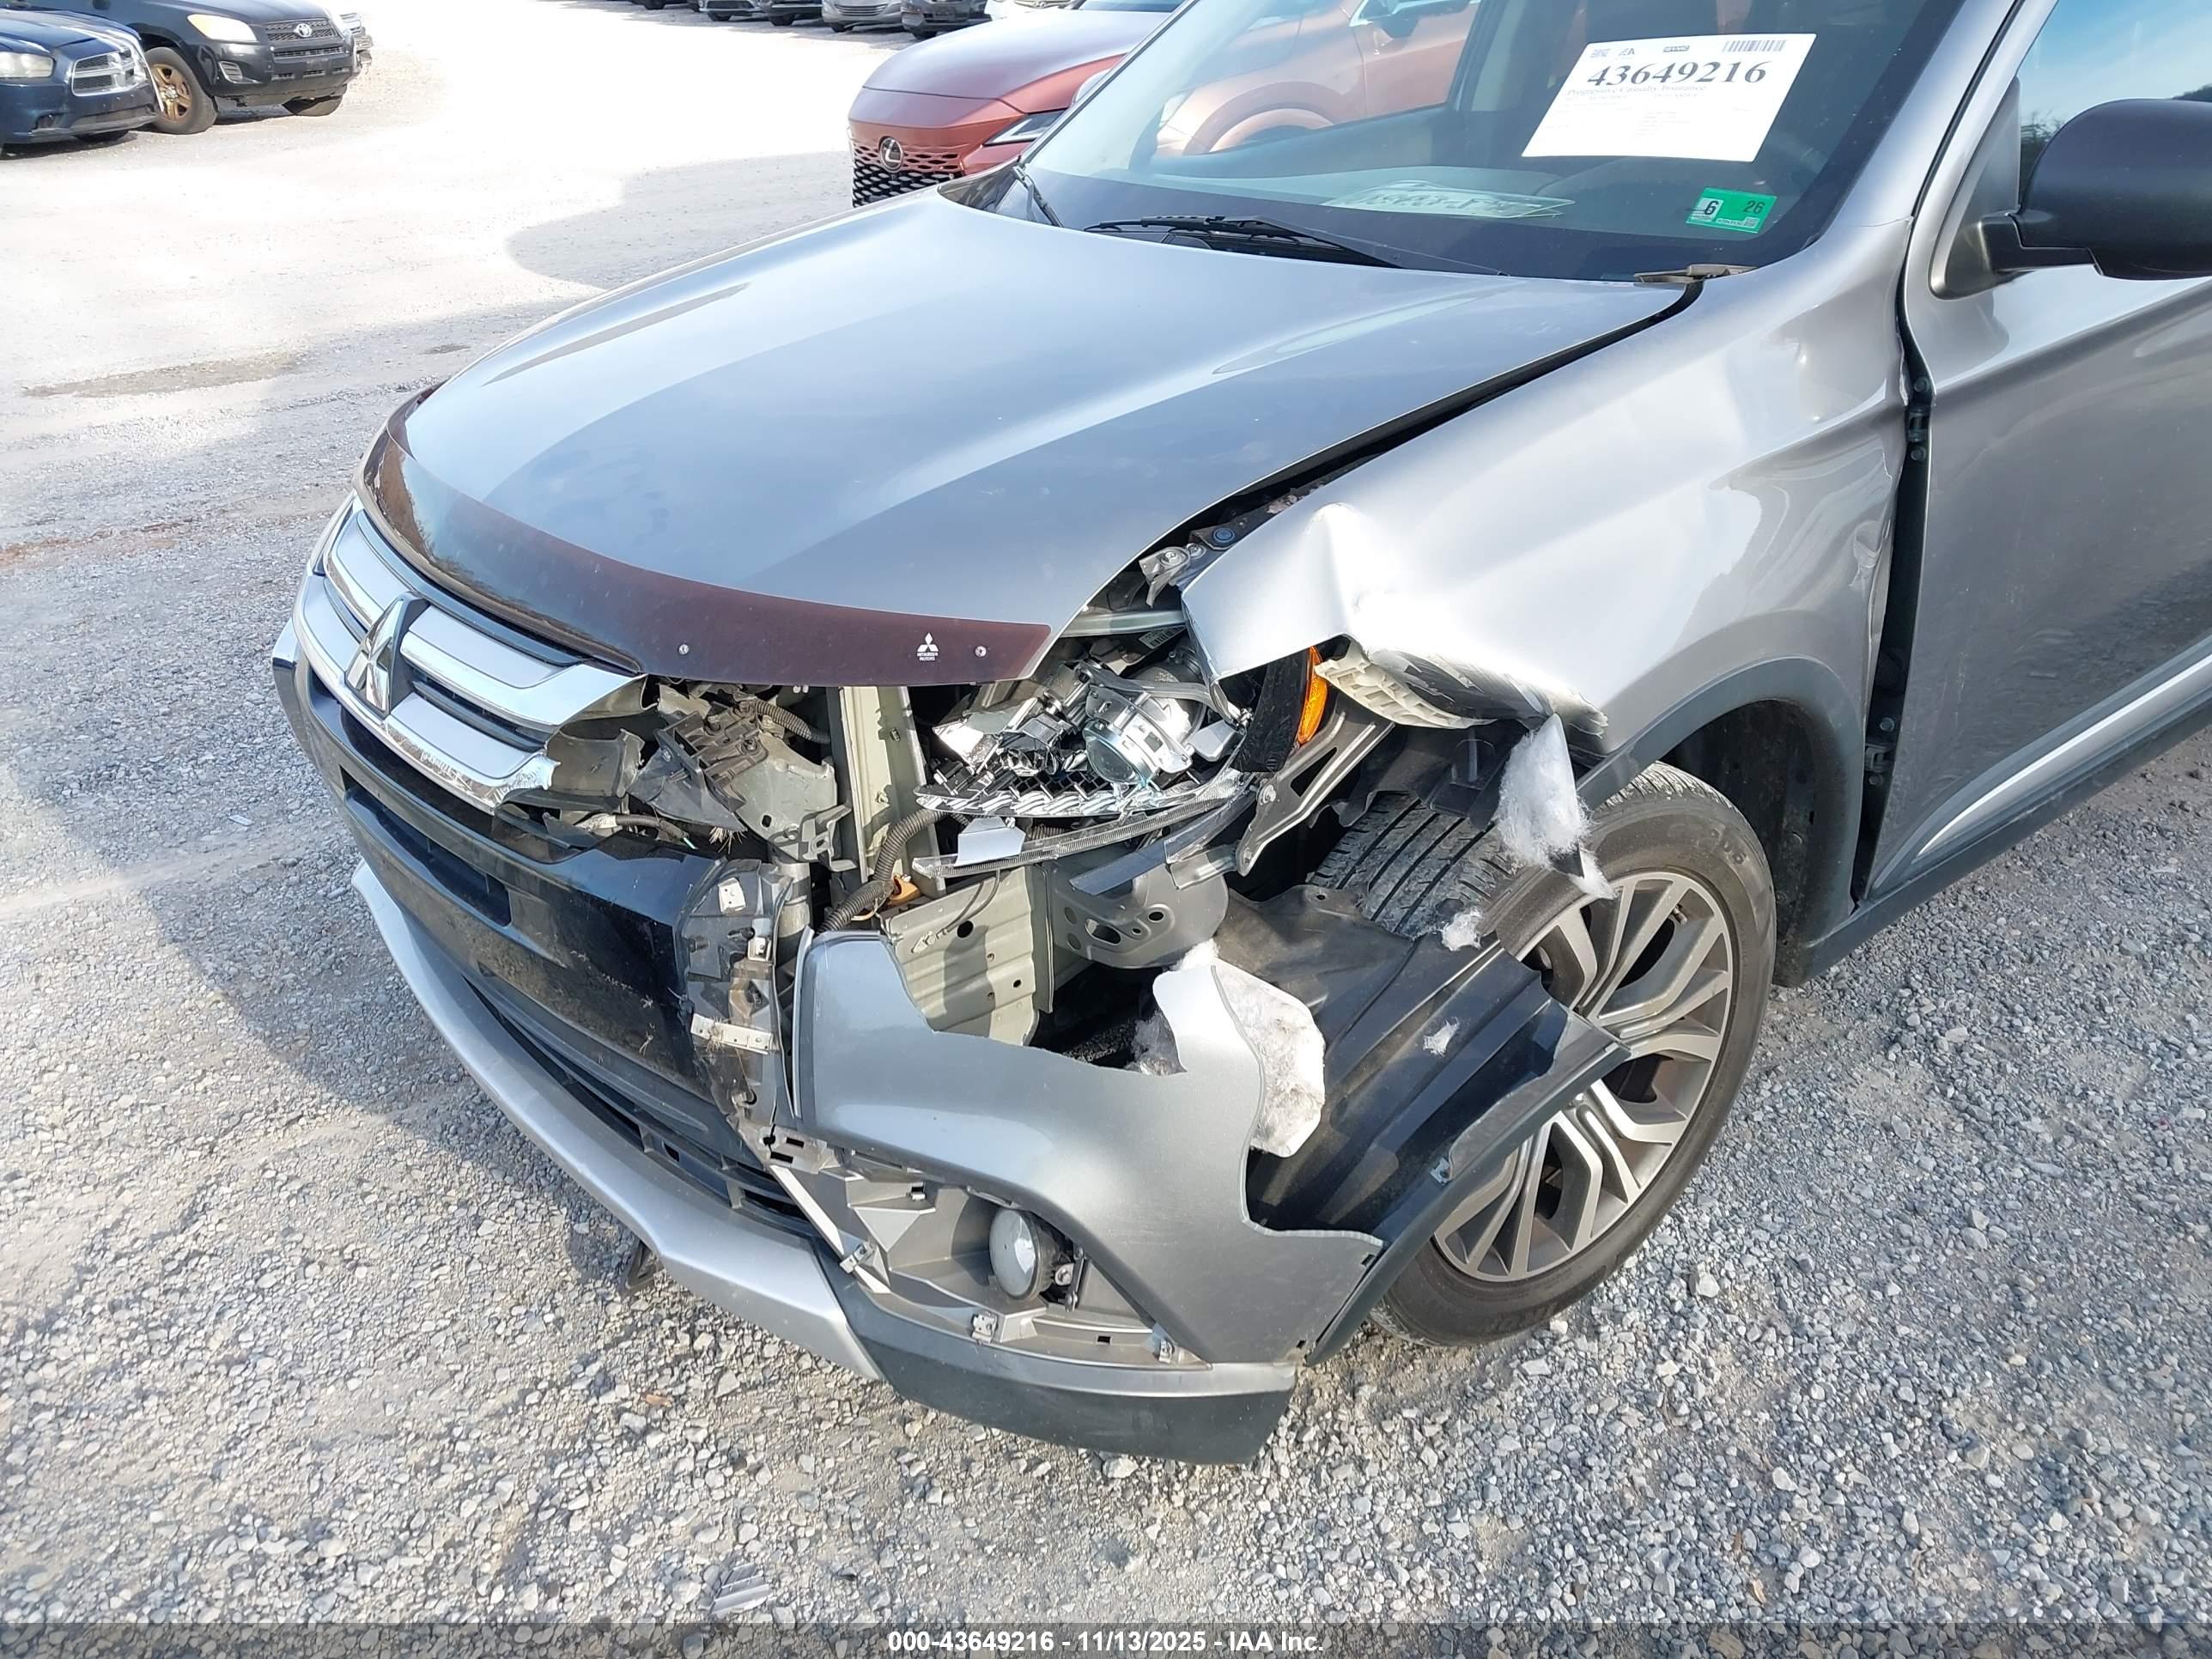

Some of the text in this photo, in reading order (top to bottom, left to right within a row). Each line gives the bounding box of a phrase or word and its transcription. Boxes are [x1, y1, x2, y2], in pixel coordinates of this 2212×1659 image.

[1587, 61, 1771, 87] 43649216
[1704, 200, 1719, 216] 6
[1743, 199, 1765, 215] 26
